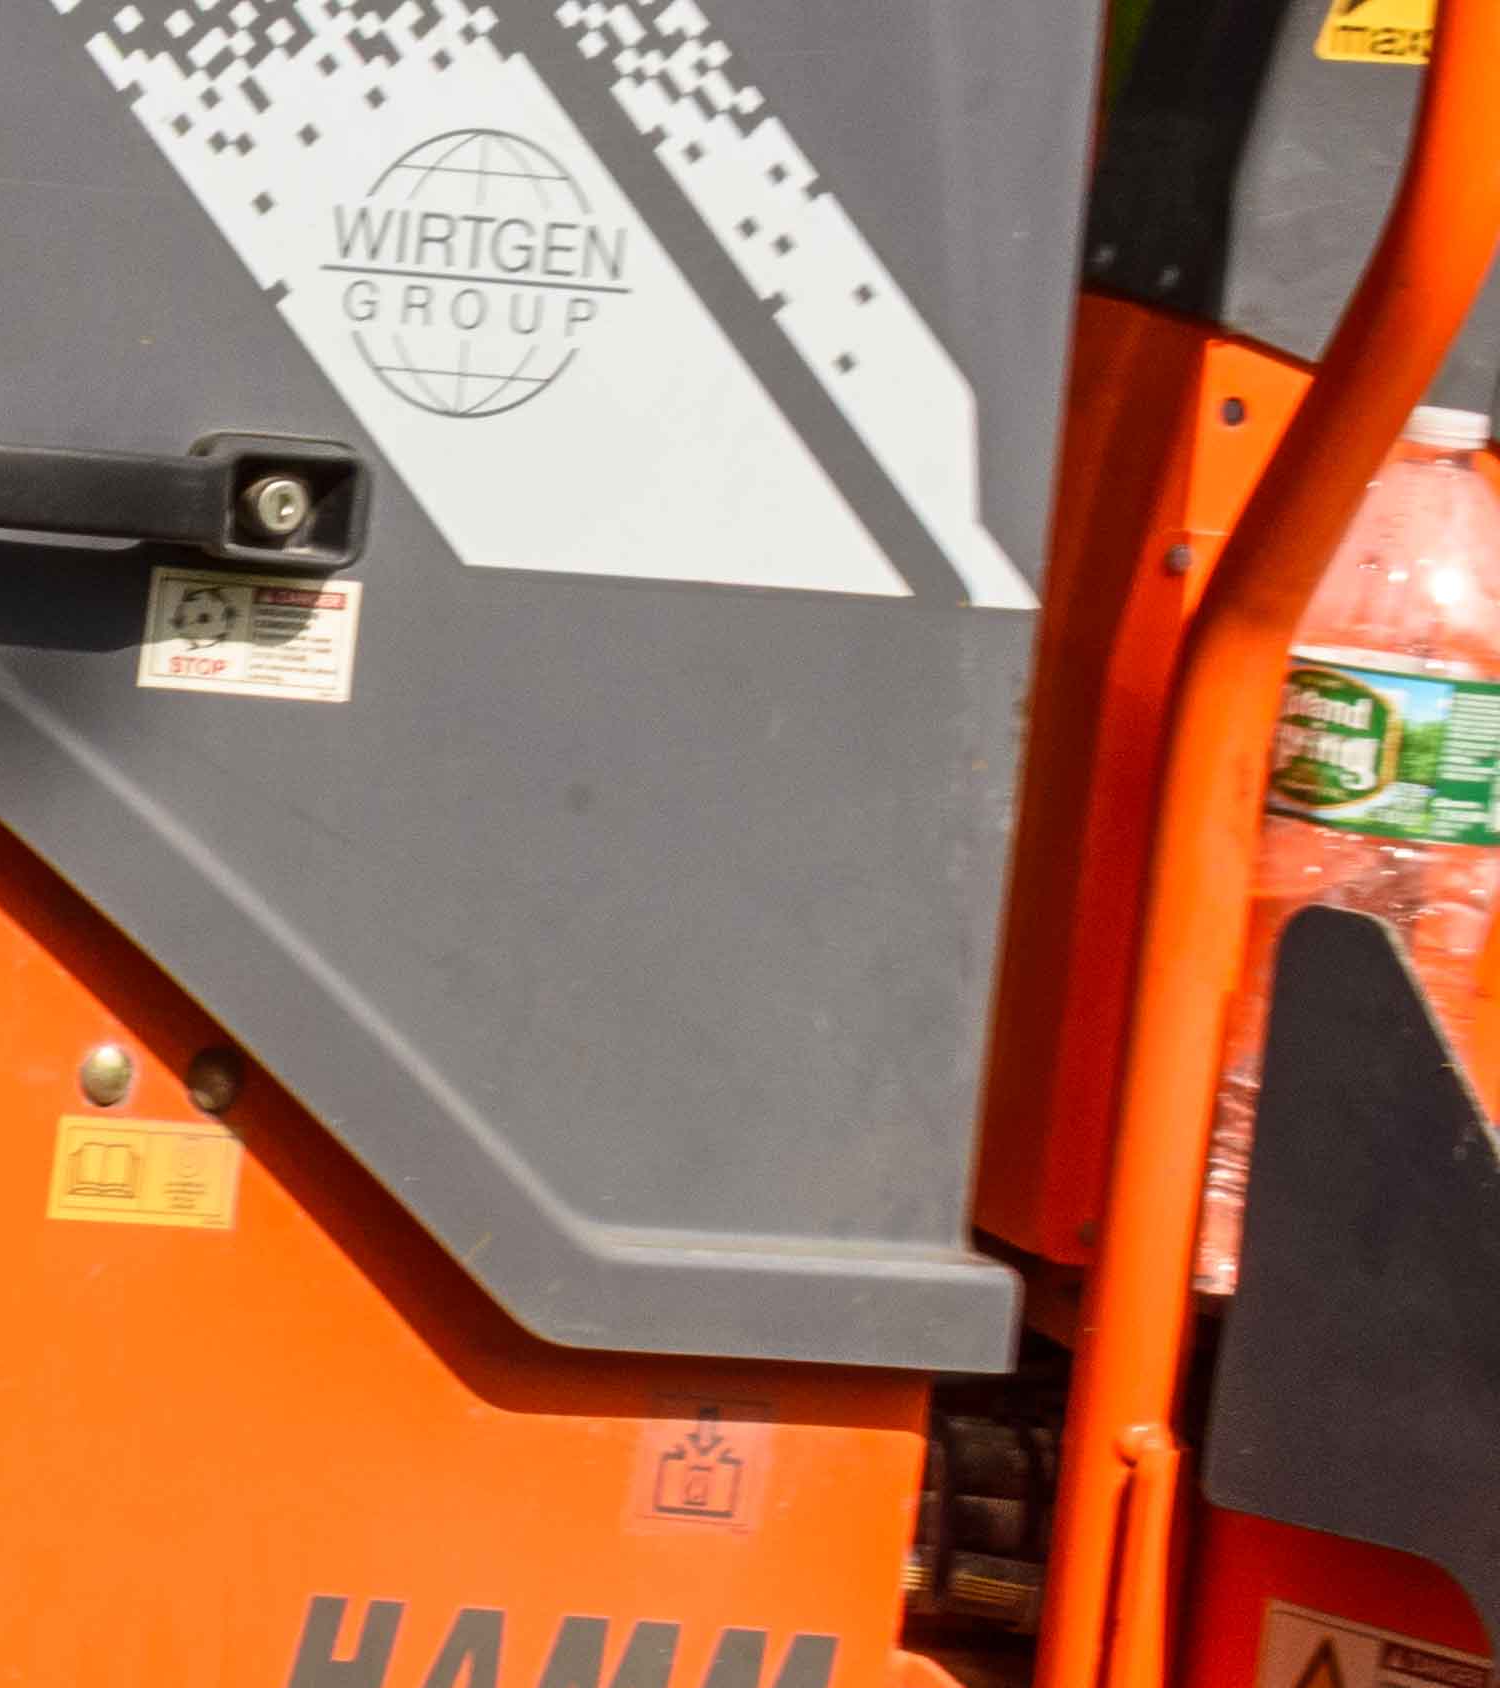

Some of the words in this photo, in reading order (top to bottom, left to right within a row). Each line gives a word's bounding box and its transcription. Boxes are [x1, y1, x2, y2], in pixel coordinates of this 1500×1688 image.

[333, 204, 628, 281] WIRTGEN
[342, 279, 598, 337] GROUP
[169, 655, 226, 674] STOP
